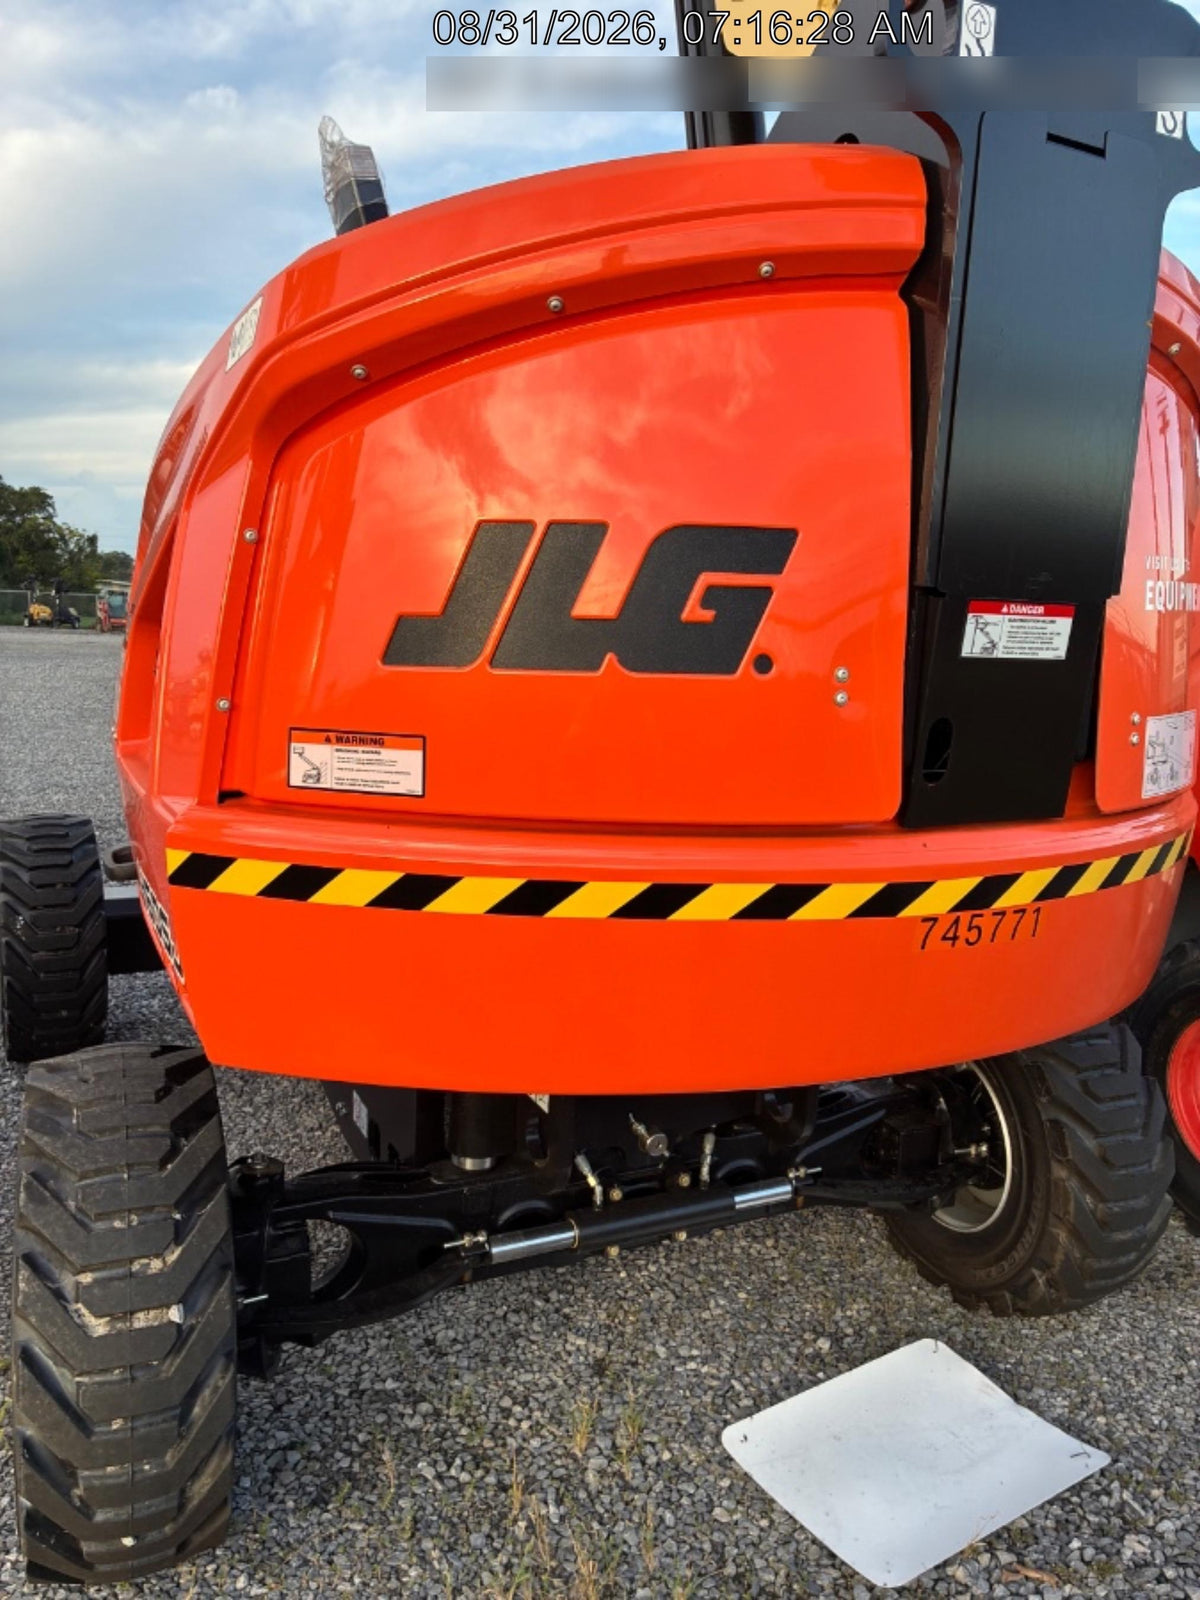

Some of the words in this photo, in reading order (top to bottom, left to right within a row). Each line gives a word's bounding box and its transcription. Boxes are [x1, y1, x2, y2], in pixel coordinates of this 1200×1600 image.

[1009, 603, 1045, 615] DANGER
[335, 735, 385, 747] WARNING
[920, 906, 1041, 950] 745771
